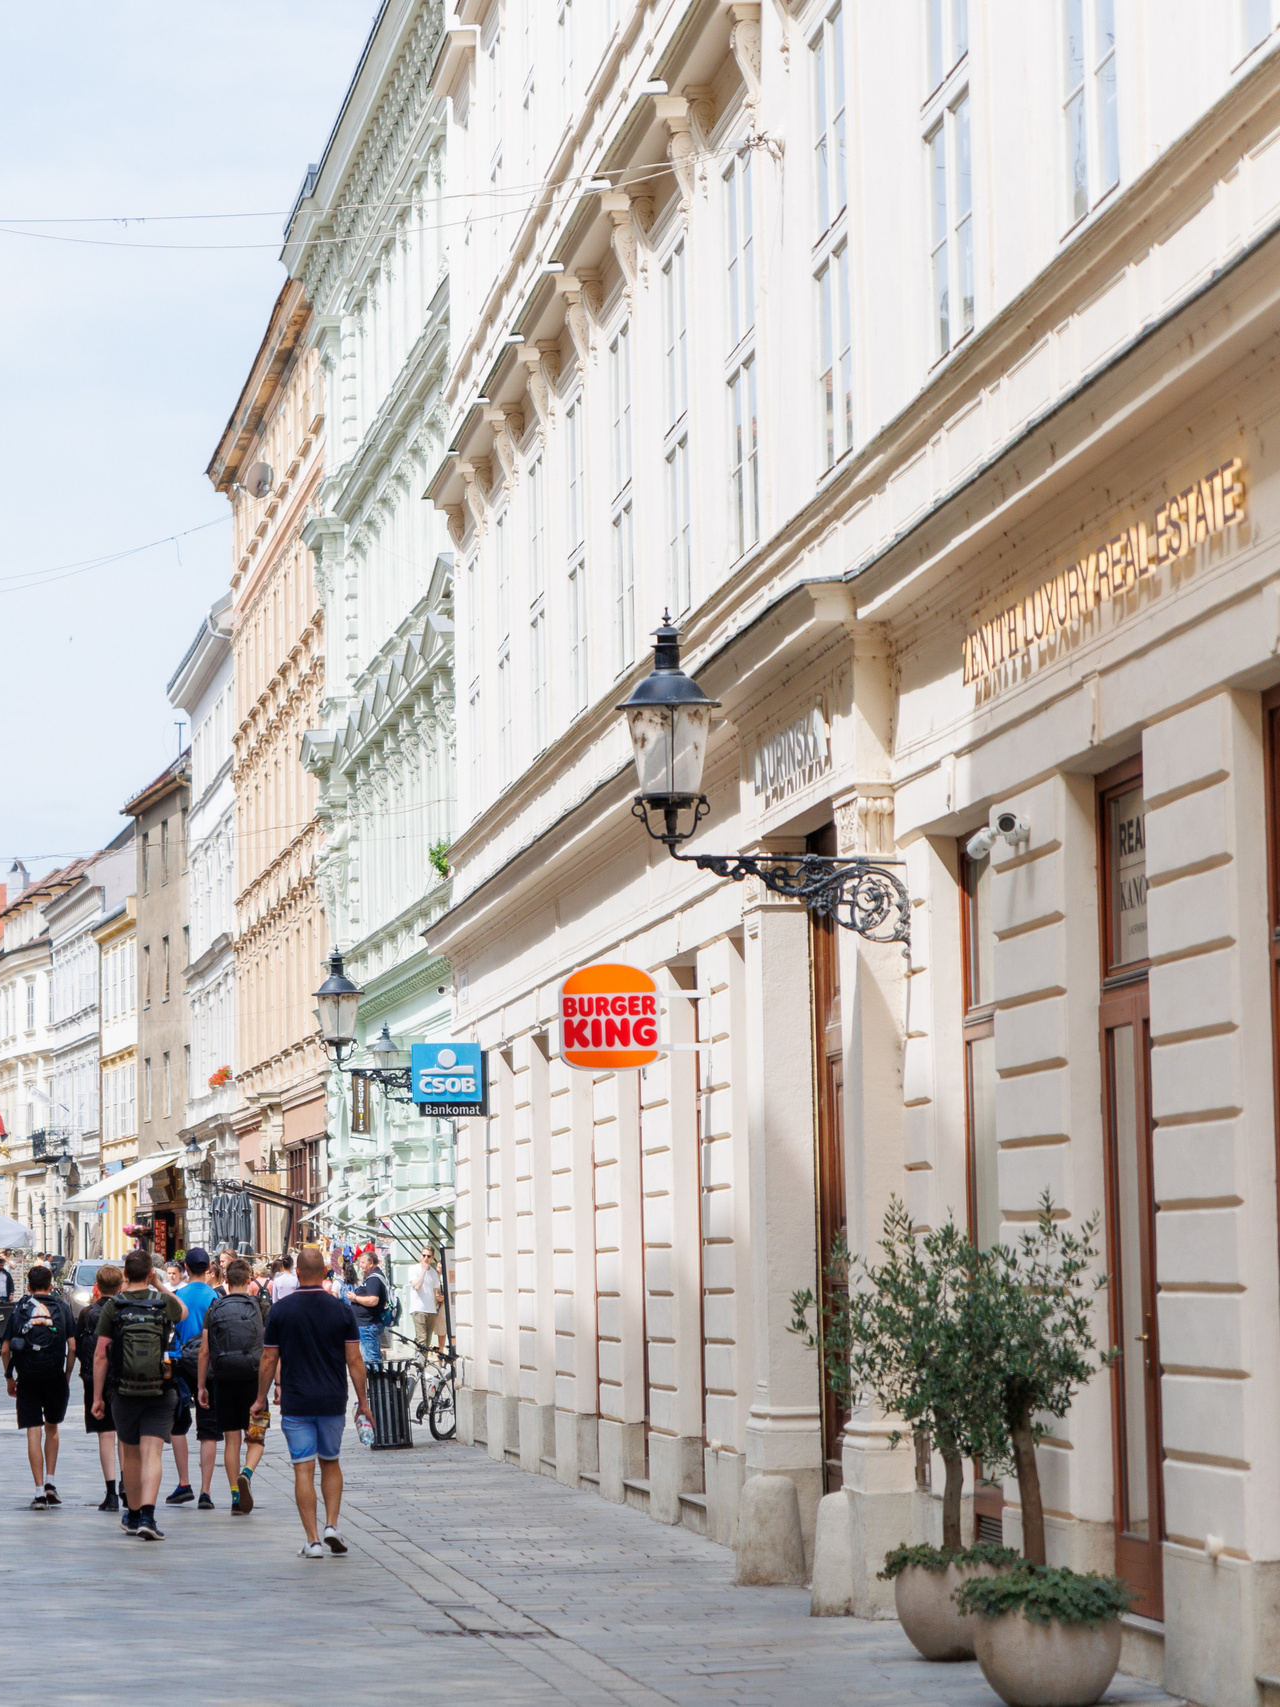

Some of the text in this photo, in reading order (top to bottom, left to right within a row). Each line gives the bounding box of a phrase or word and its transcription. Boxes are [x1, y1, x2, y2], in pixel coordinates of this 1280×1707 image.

[962, 457, 1245, 687] ZENITH LUXURY REAL ESTATE
[562, 995, 657, 1018] BURGER
[563, 1017, 658, 1049] KING
[419, 1075, 476, 1094] ČSOB
[425, 1104, 481, 1116] Bankomat
